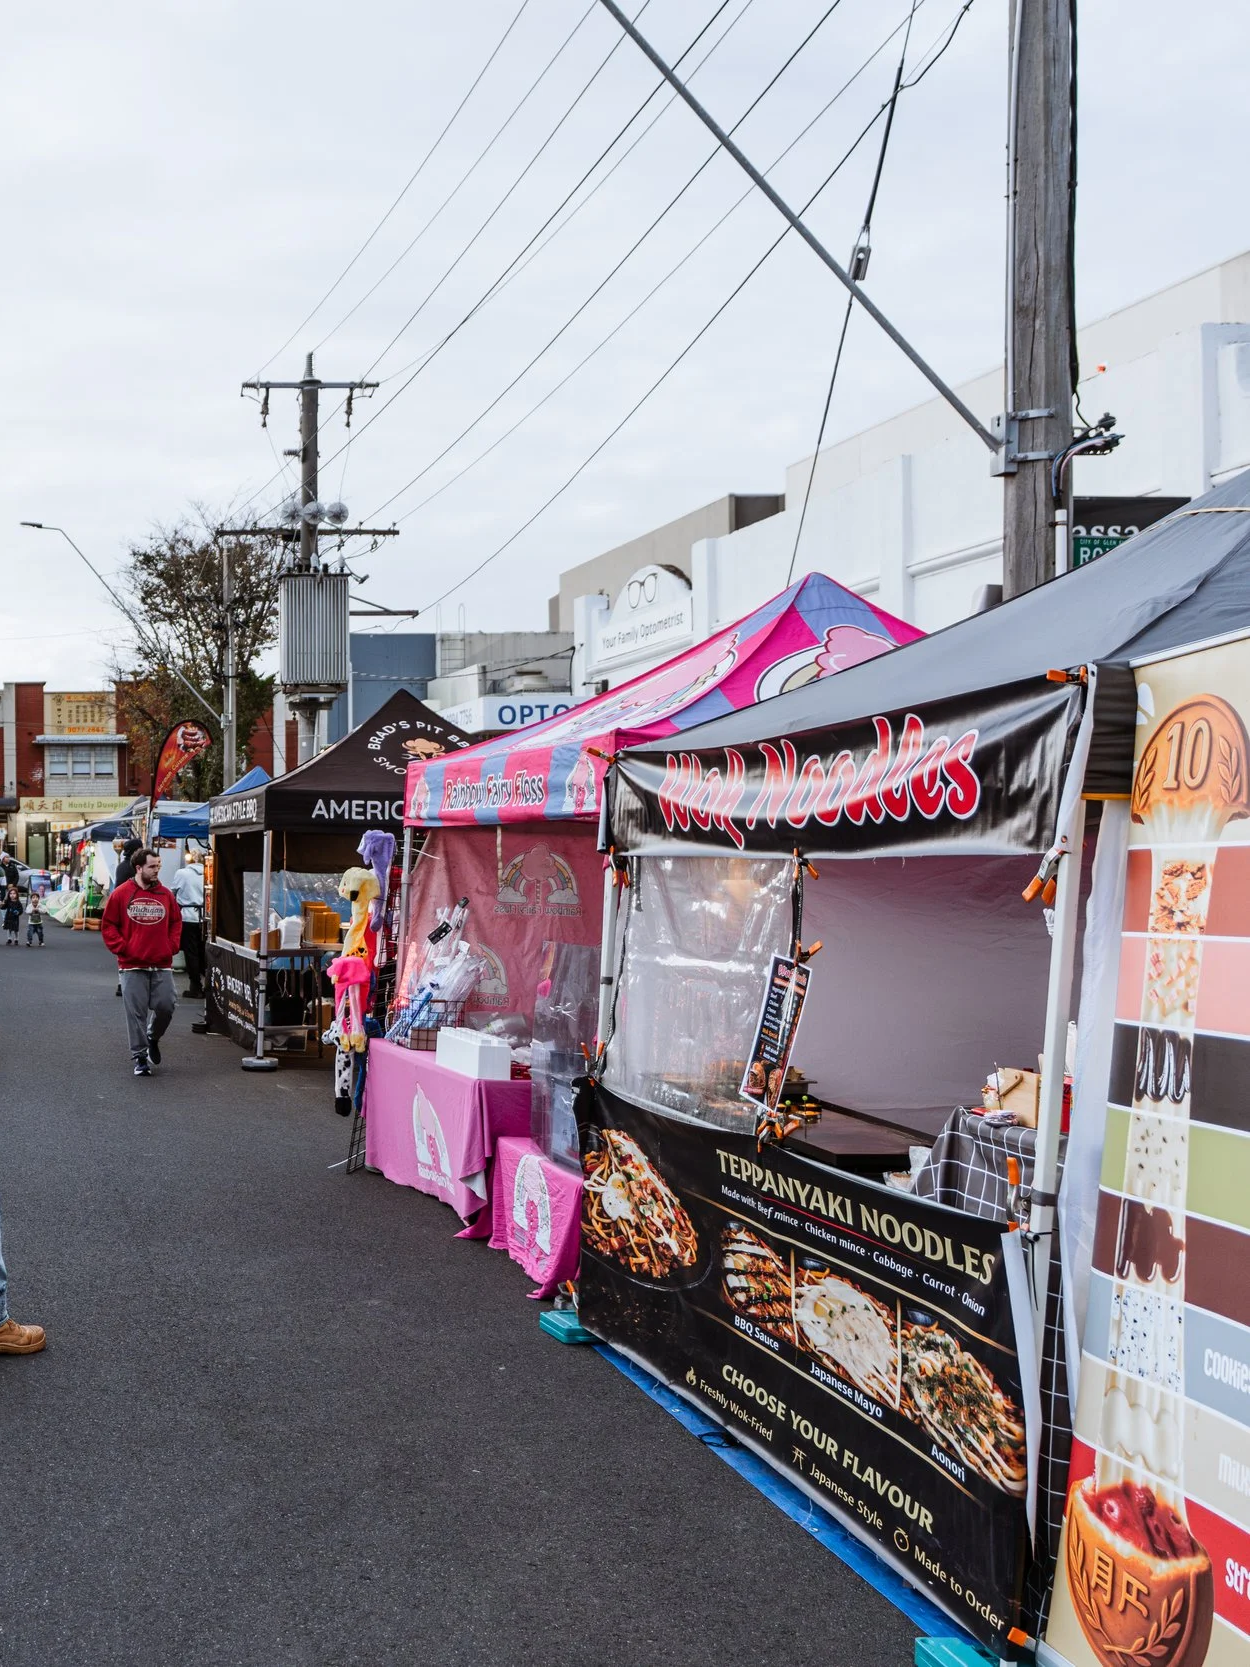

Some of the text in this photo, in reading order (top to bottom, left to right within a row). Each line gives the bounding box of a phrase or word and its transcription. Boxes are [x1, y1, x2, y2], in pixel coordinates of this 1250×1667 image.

[1103, 538, 1117, 546] GLEN
[602, 612, 684, 649] Your Family Optometrist
[368, 720, 410, 750] BRAD'S
[416, 721, 444, 734] PIT
[1162, 717, 1213, 791] 10
[232, 800, 246, 820] STYLE
[246, 798, 258, 822] BBQ
[442, 770, 544, 811] Rainbow Fairy Floss
[658, 713, 981, 850] Wok Noodles
[716, 1149, 996, 1286] TEPPANYAKI NOODLES
[721, 1185, 740, 1201] Made
[758, 1201, 774, 1220] Beef
[774, 1210, 798, 1228] mince
[804, 1222, 837, 1244] Chicken
[839, 1238, 866, 1256] mince
[872, 1251, 914, 1278] Cabbage
[922, 1273, 956, 1298] Carrot
[962, 1292, 986, 1317] Onion
[734, 1315, 780, 1351] BBQ Sauce
[700, 1380, 774, 1442] Freshly Wok-Fried
[810, 1362, 883, 1419] Japanese Mayo
[722, 1364, 934, 1534] CHOOSE YOUR FLAVOUR
[931, 1444, 966, 1483] Aonori
[809, 1463, 884, 1530] Japanese Style
[914, 1545, 1005, 1631] Made to Order
